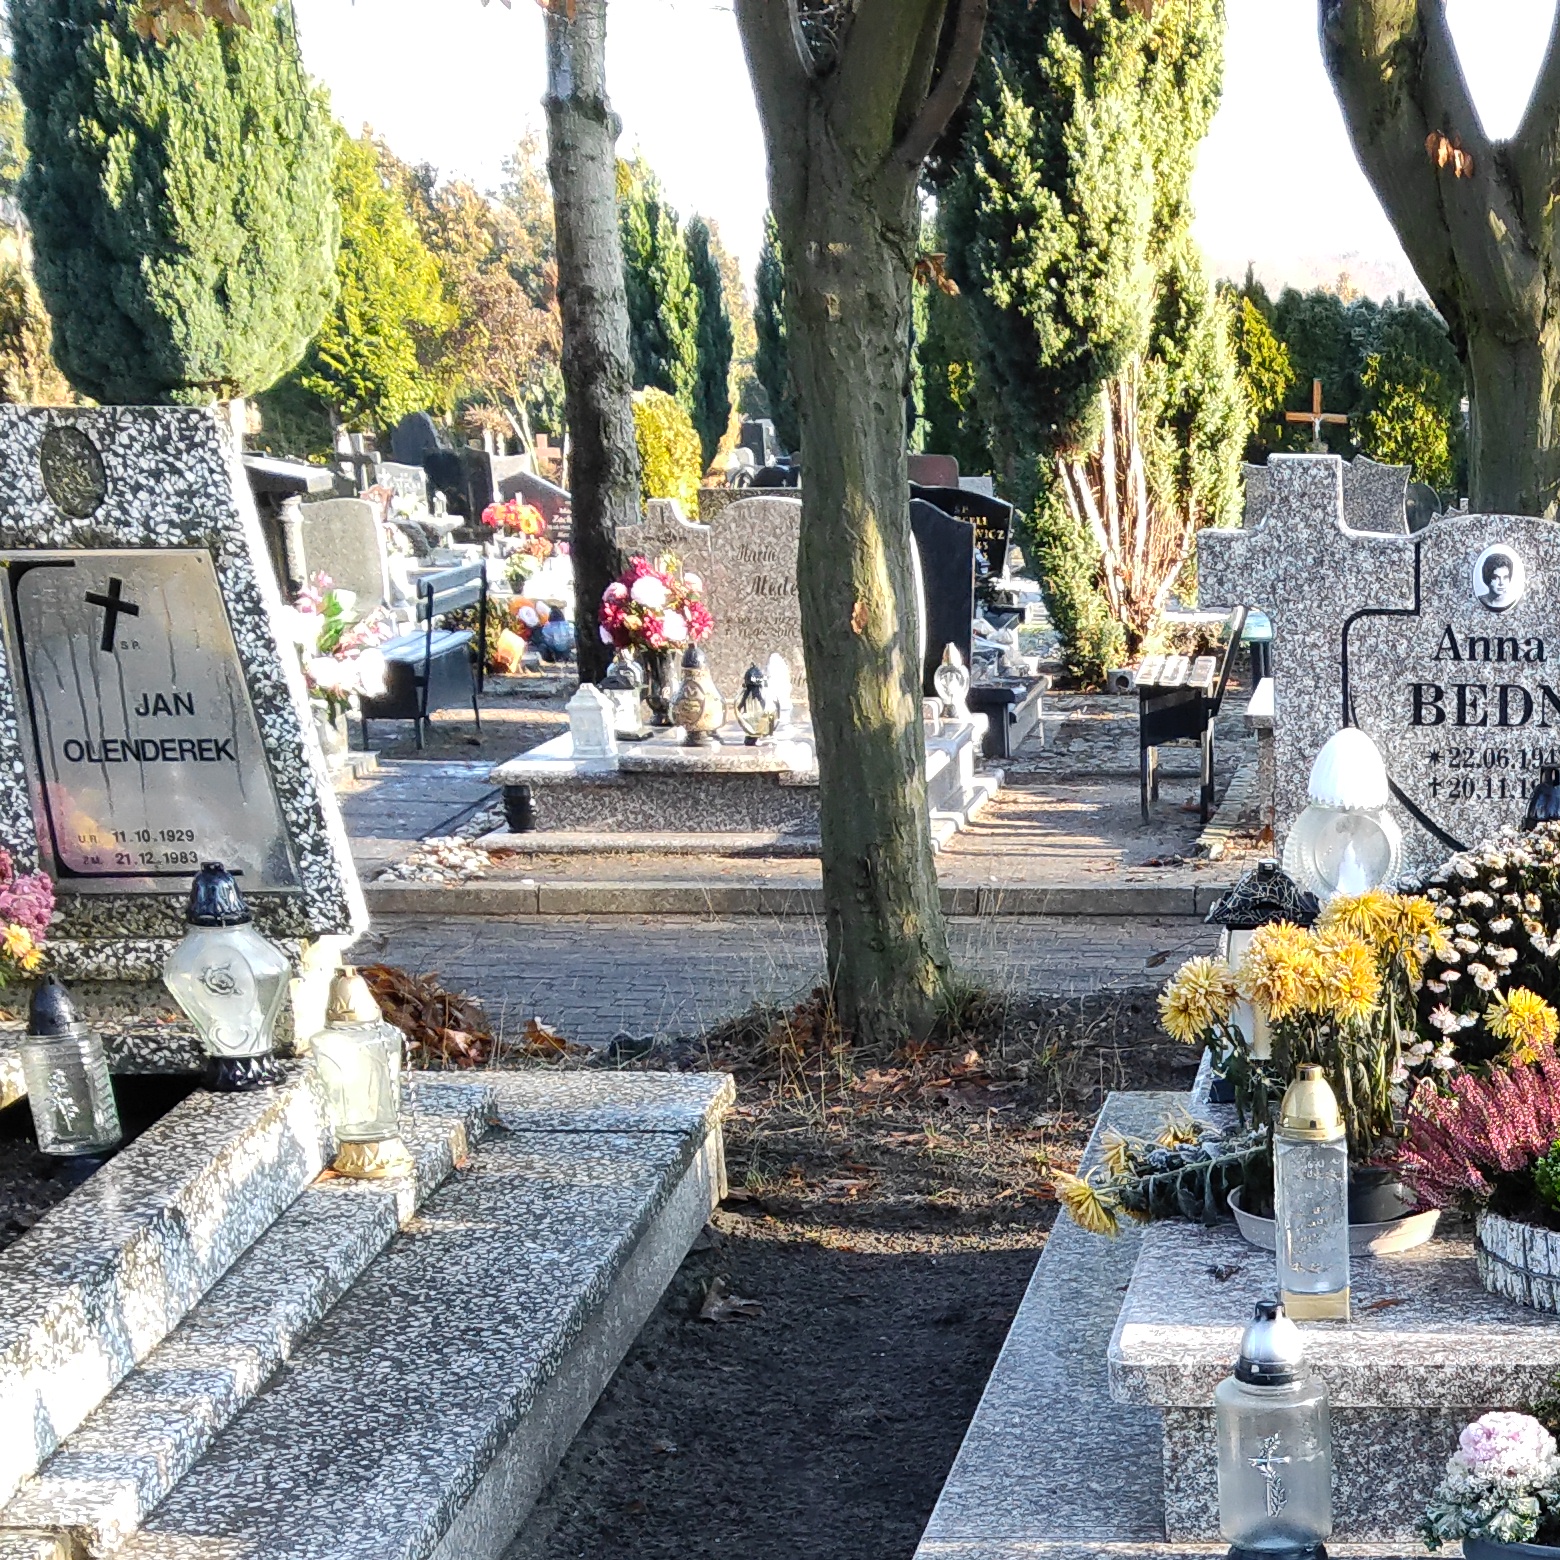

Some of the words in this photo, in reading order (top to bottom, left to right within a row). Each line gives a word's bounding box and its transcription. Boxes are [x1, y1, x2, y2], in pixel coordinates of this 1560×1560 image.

[1432, 623, 1545, 663] Anna
[134, 692, 196, 717] JAN
[63, 738, 237, 763] OLENDEREK
[1446, 777, 1537, 800] 20.11.1
[112, 829, 196, 844] 11.10.1929
[115, 850, 199, 867] 21.12.1983
